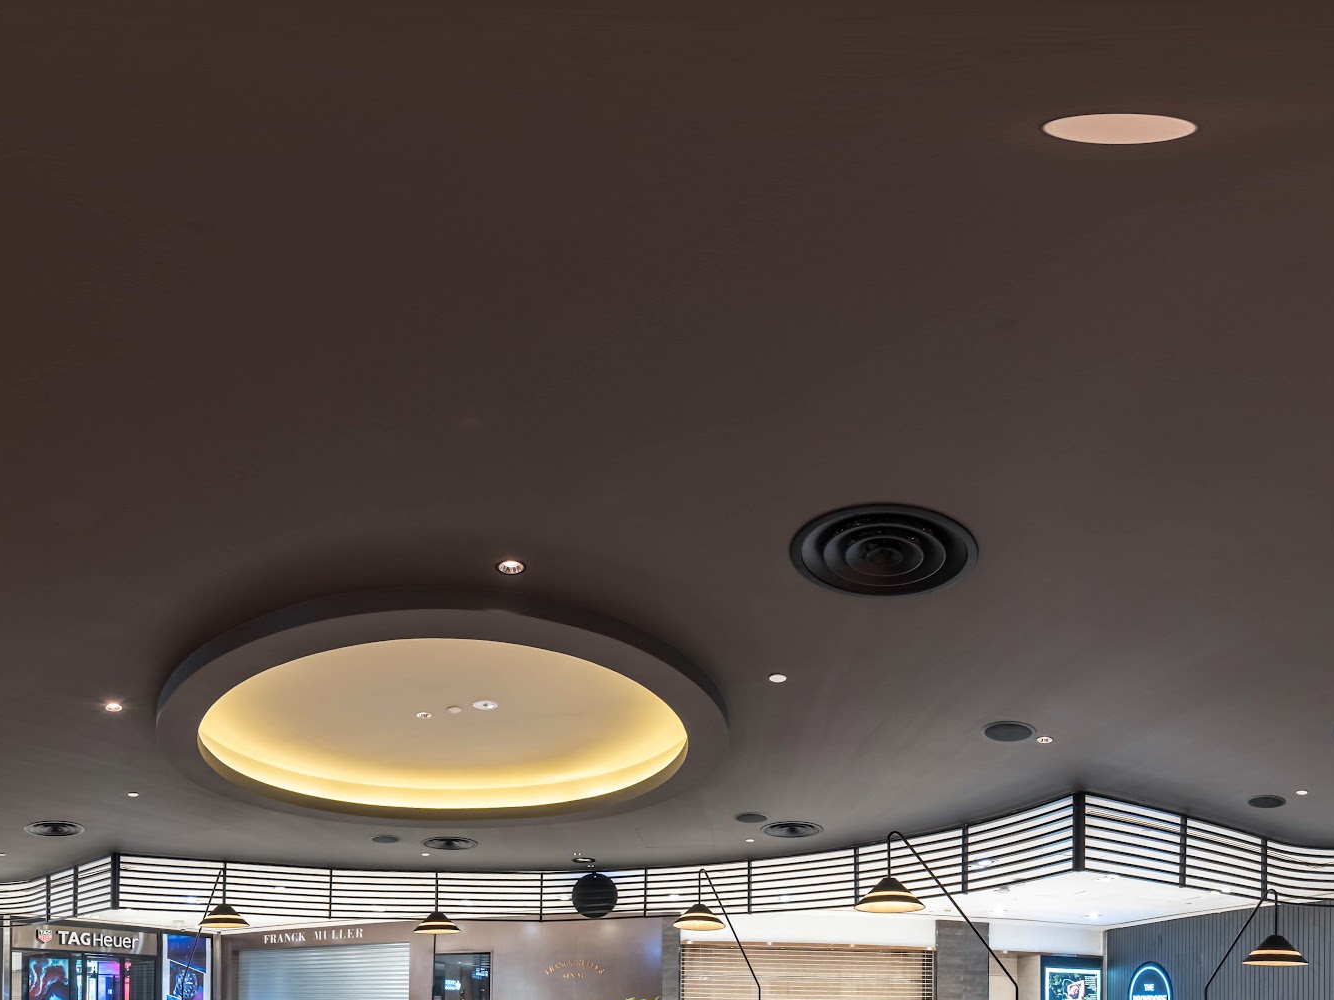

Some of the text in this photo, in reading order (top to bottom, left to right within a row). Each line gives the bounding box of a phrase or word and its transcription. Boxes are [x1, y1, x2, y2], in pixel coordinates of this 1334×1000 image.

[57, 930, 139, 949] TAG Heuer
[263, 932, 306, 944] FRANCK
